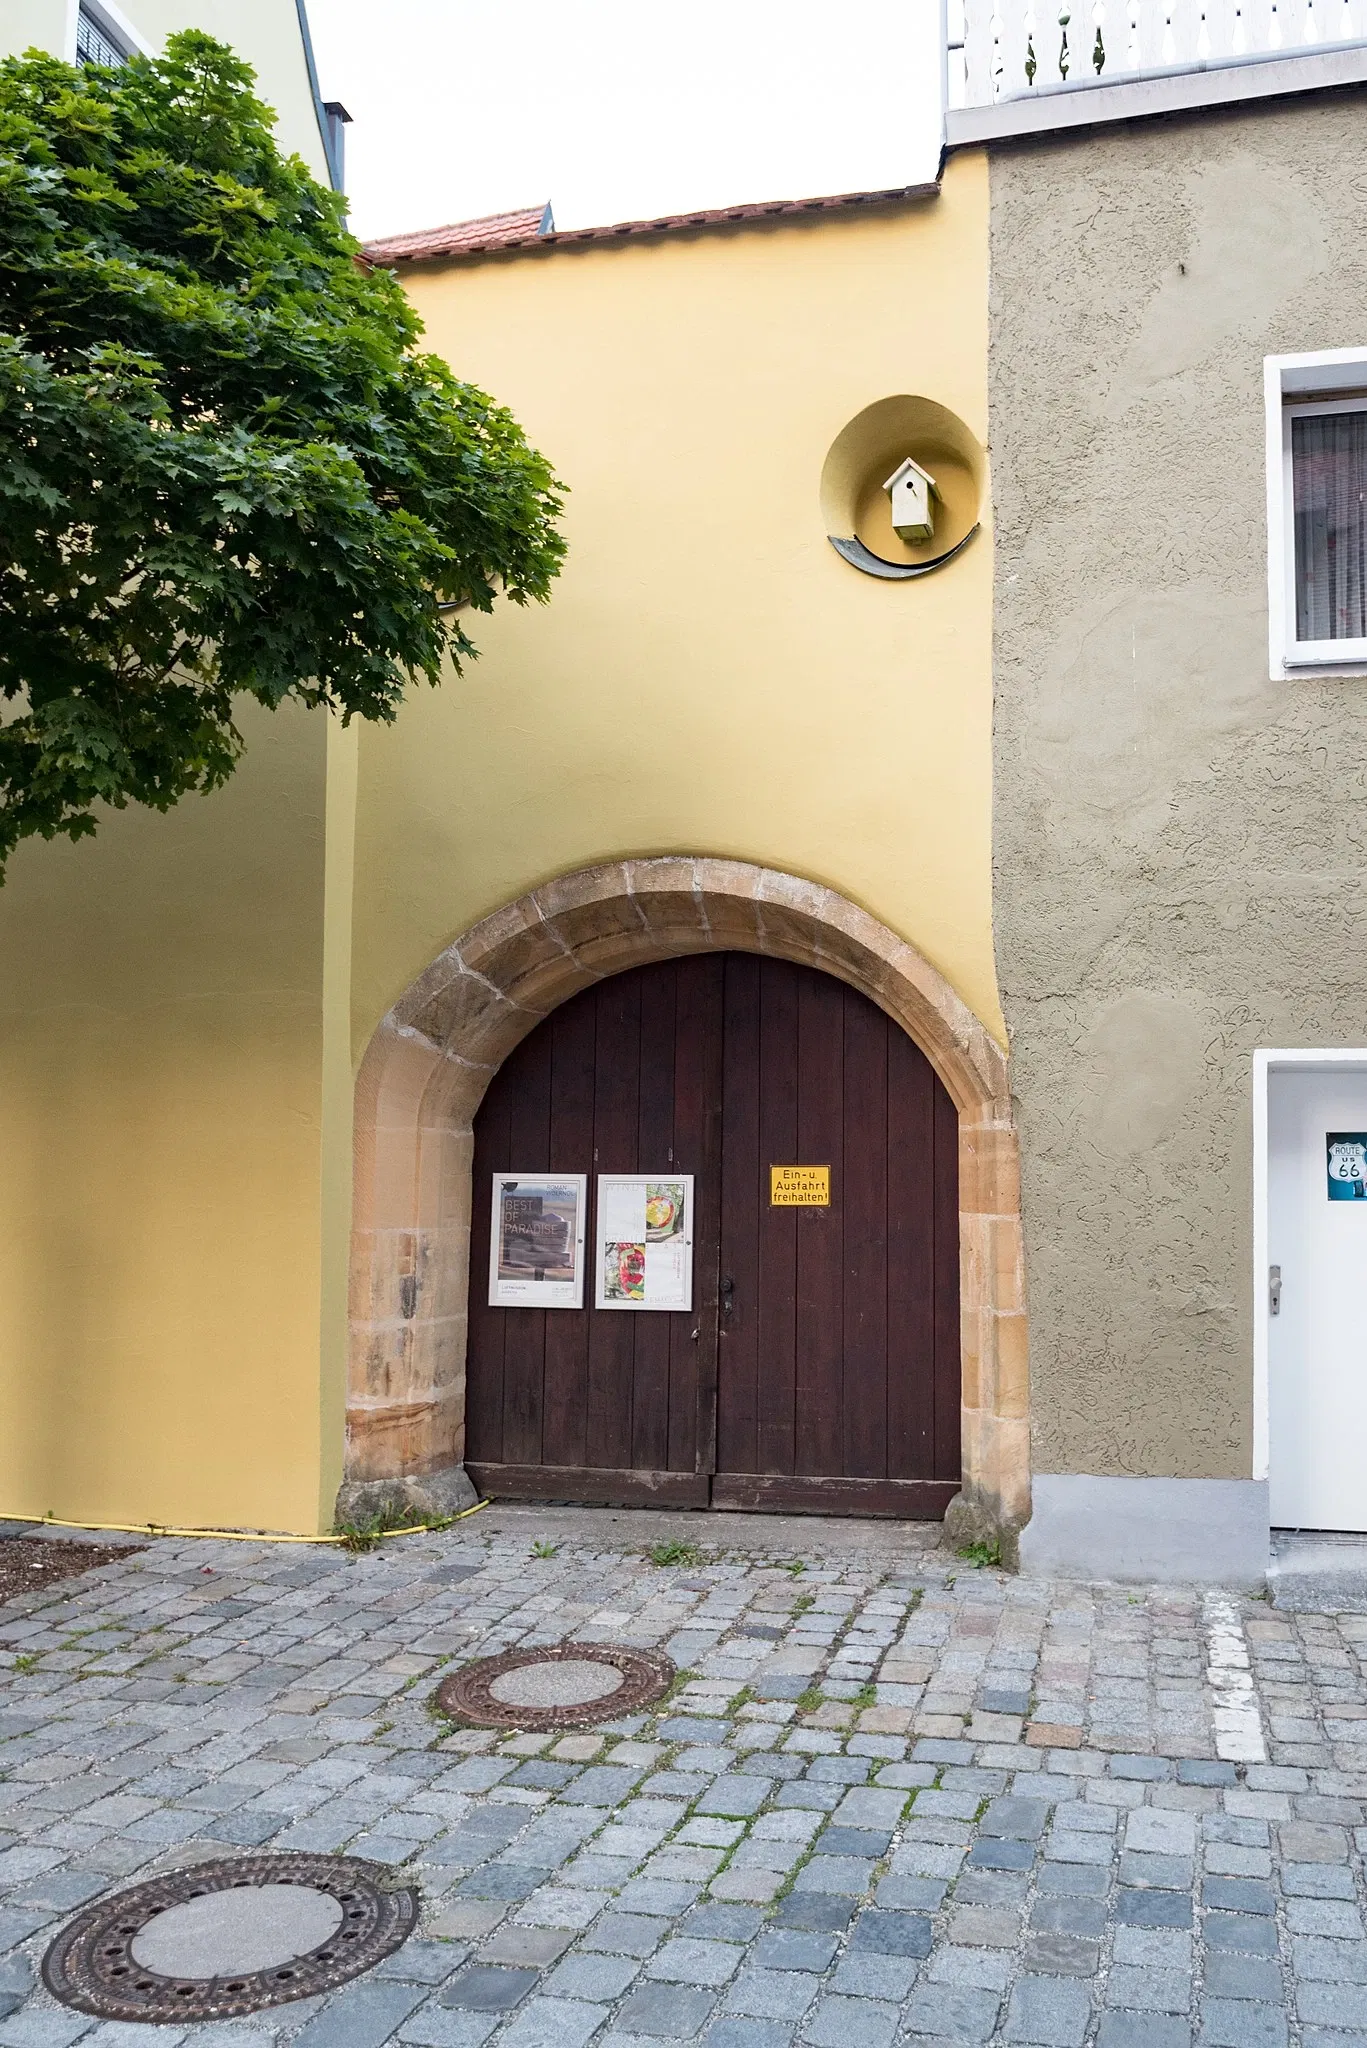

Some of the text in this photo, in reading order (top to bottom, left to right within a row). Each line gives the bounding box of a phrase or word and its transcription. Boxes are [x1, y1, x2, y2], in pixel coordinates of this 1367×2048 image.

[1335, 1146, 1360, 1155] ROUTE
[1339, 1163, 1360, 1178] 66
[776, 1181, 825, 1190] Ausfahrt
[773, 1192, 828, 1202] freihalten!
[505, 1199, 533, 1211] BEST
[504, 1211, 520, 1222] OF
[504, 1223, 559, 1235] PARADISE
